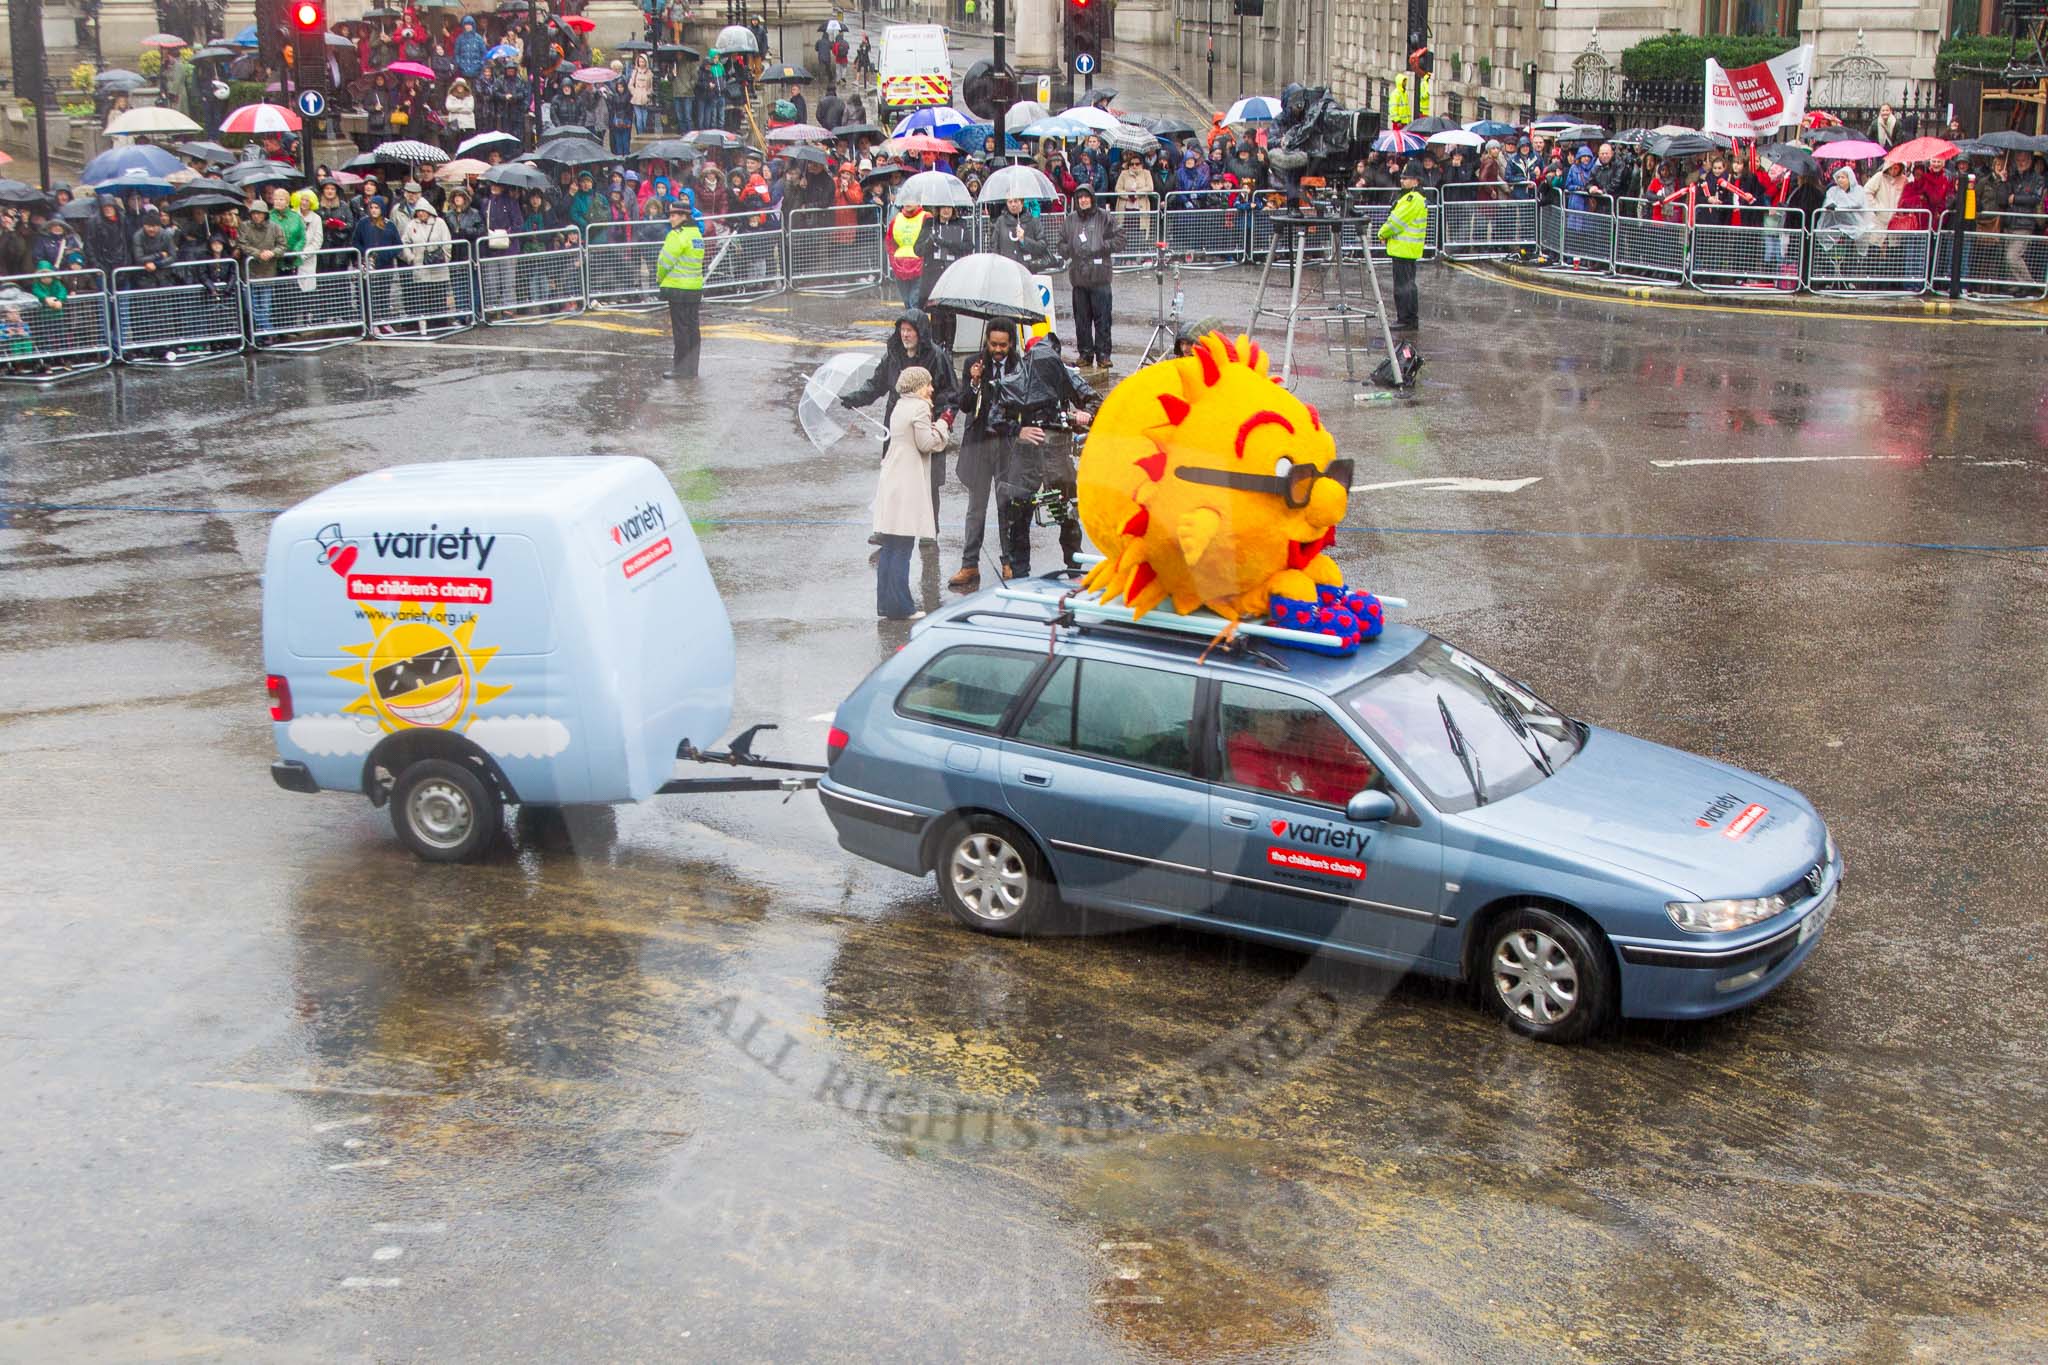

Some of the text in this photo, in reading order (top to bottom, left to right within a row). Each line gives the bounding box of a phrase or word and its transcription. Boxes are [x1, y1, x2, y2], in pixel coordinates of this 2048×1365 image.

[1736, 78, 1759, 90] BEAT
[619, 503, 667, 542] variety
[373, 523, 496, 571] variety
[351, 579, 488, 601] the children's charity
[354, 609, 477, 627] www.variety.org.uk
[1701, 791, 1746, 824] variety
[1288, 822, 1371, 858] variety
[1271, 850, 1363, 877] the children's charity
